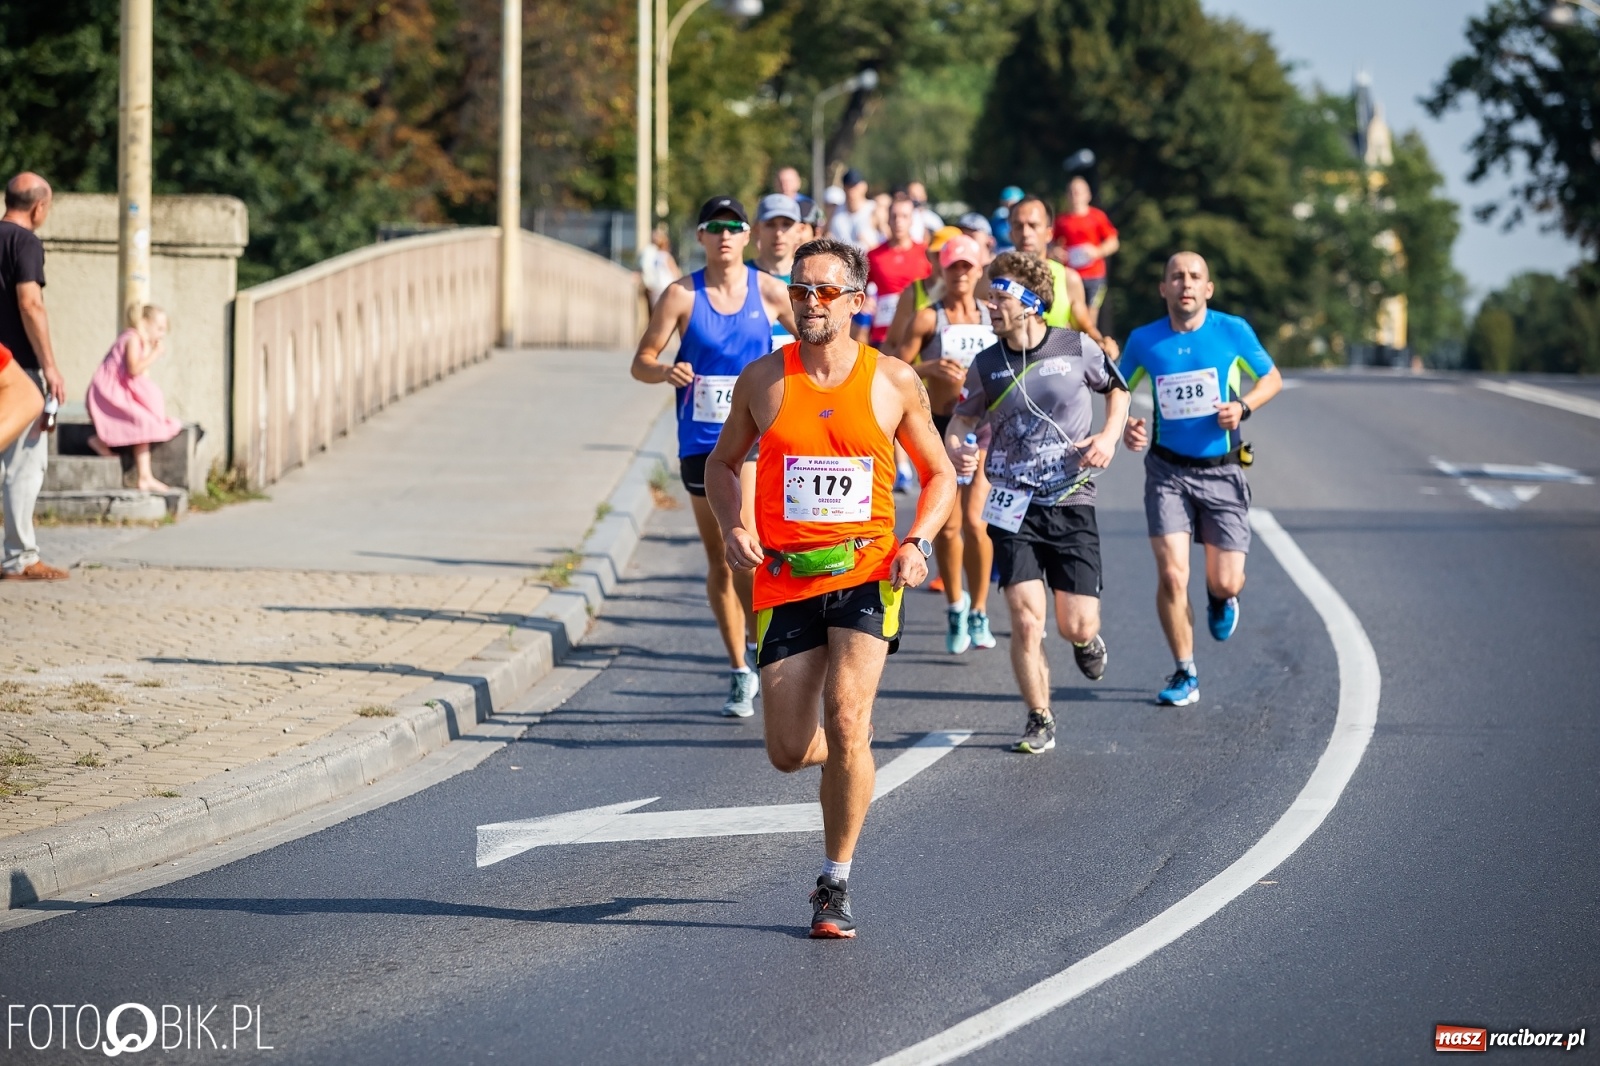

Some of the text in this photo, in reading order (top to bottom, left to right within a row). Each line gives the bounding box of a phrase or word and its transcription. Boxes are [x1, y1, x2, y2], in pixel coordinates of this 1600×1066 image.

[715, 390, 733, 404] 76
[1175, 384, 1204, 400] 238
[812, 475, 852, 496] 179
[990, 488, 1014, 508] 343
